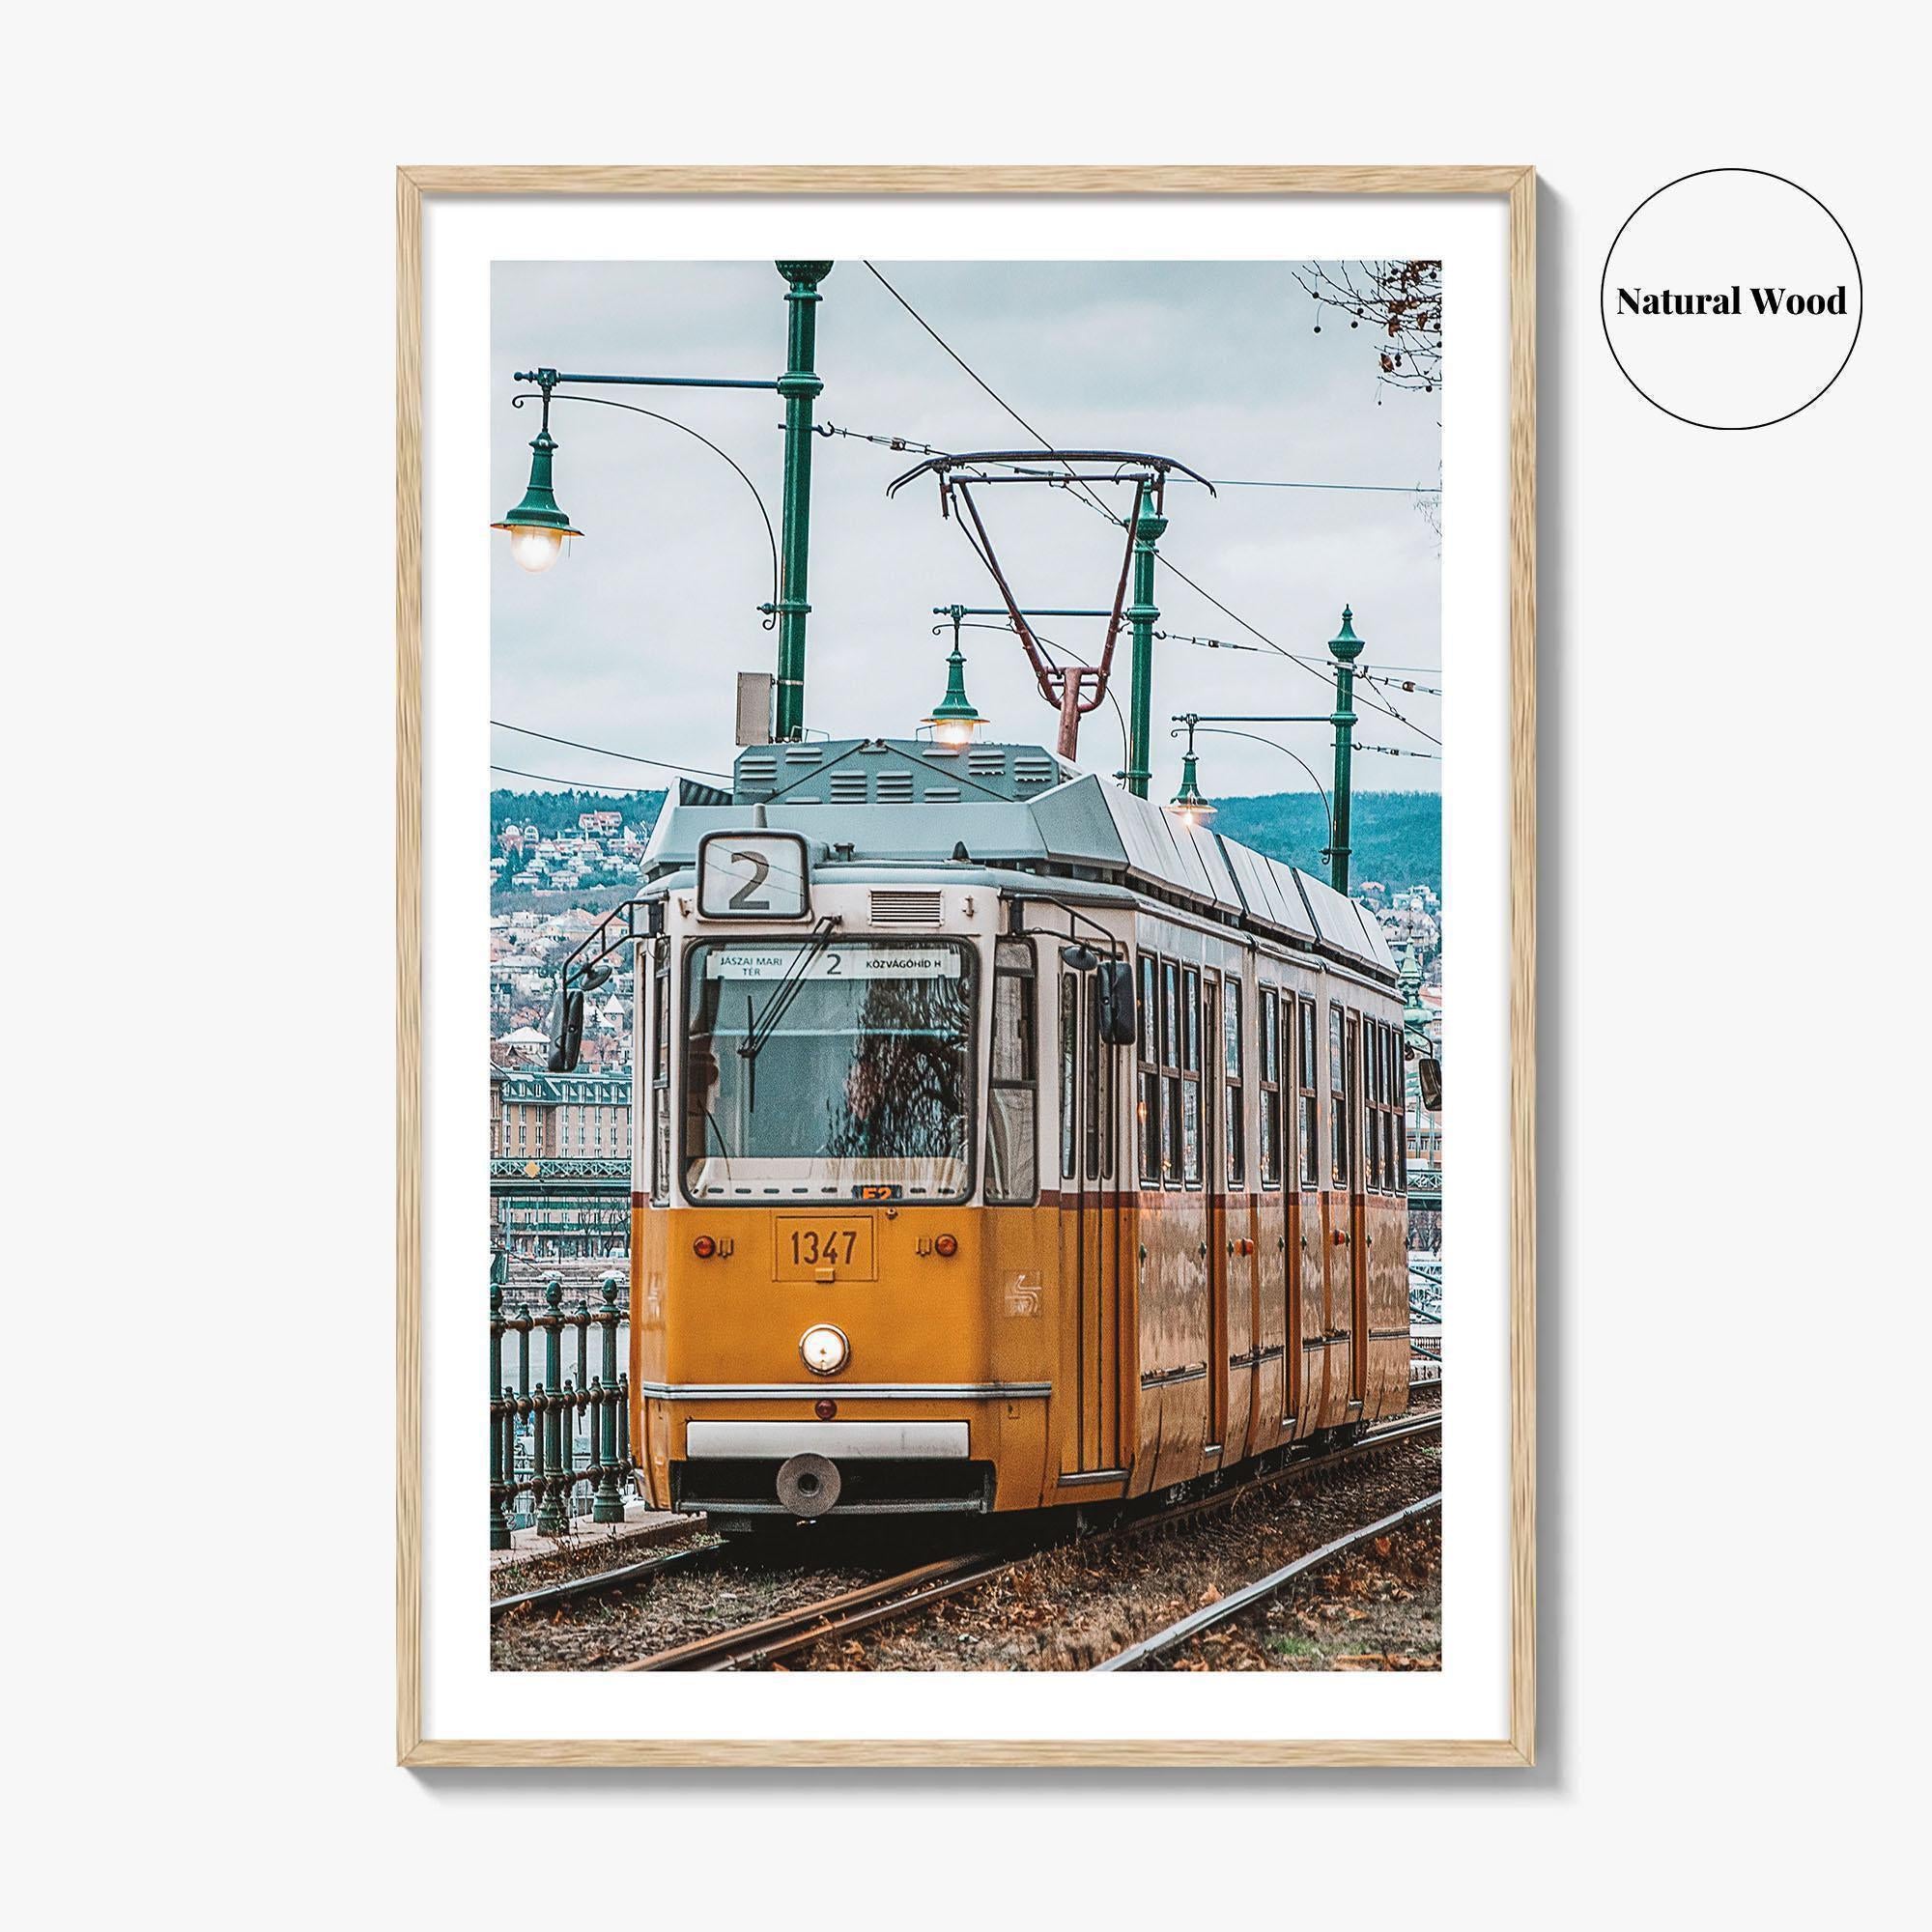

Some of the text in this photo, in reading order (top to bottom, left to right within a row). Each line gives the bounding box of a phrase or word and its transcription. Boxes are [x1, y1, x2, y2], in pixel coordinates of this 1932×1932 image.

[728, 850, 770, 910] 2
[756, 956, 782, 966] MARI
[827, 953, 841, 975] 2
[934, 959, 942, 968] H
[791, 1231, 857, 1264] 1347
